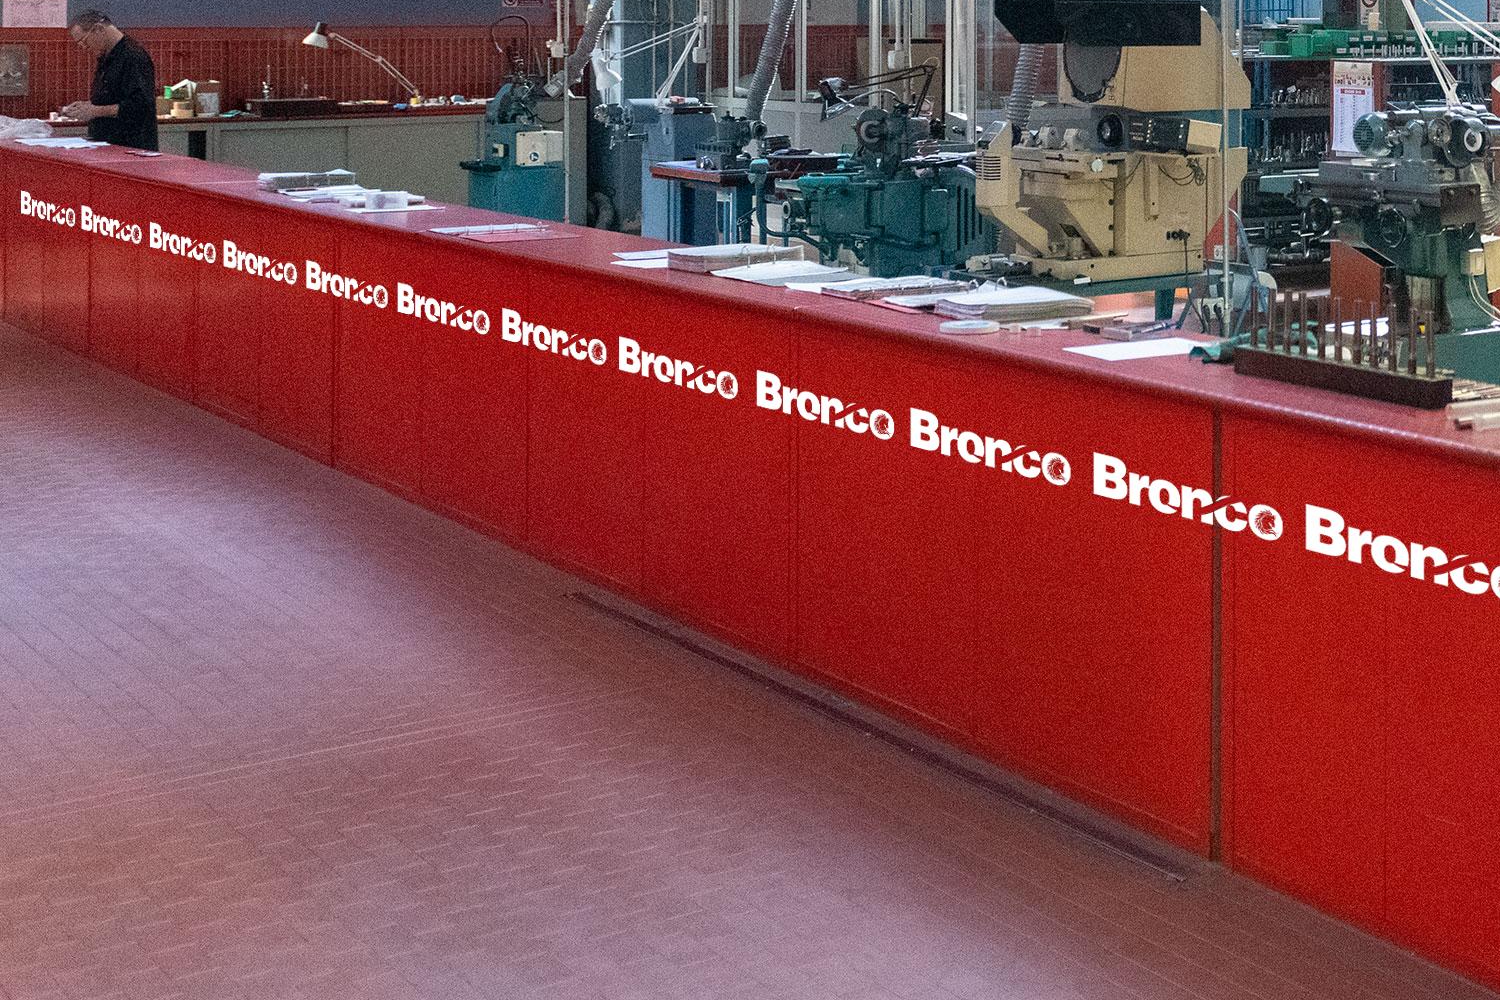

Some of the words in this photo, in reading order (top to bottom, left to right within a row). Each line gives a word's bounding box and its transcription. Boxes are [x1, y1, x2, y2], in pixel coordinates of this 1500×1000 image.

[20, 190, 76, 228] Bronco
[80, 205, 143, 245] Bronco
[149, 221, 217, 264] Bronco
[223, 239, 298, 285] Bronco
[305, 259, 389, 309] Bronco
[397, 282, 491, 335] Bronco
[501, 307, 607, 366] Bronco
[618, 336, 739, 400] Bronco
[756, 369, 895, 441] Bronco
[910, 407, 1072, 486] Bronco
[1093, 451, 1284, 541] Bronco
